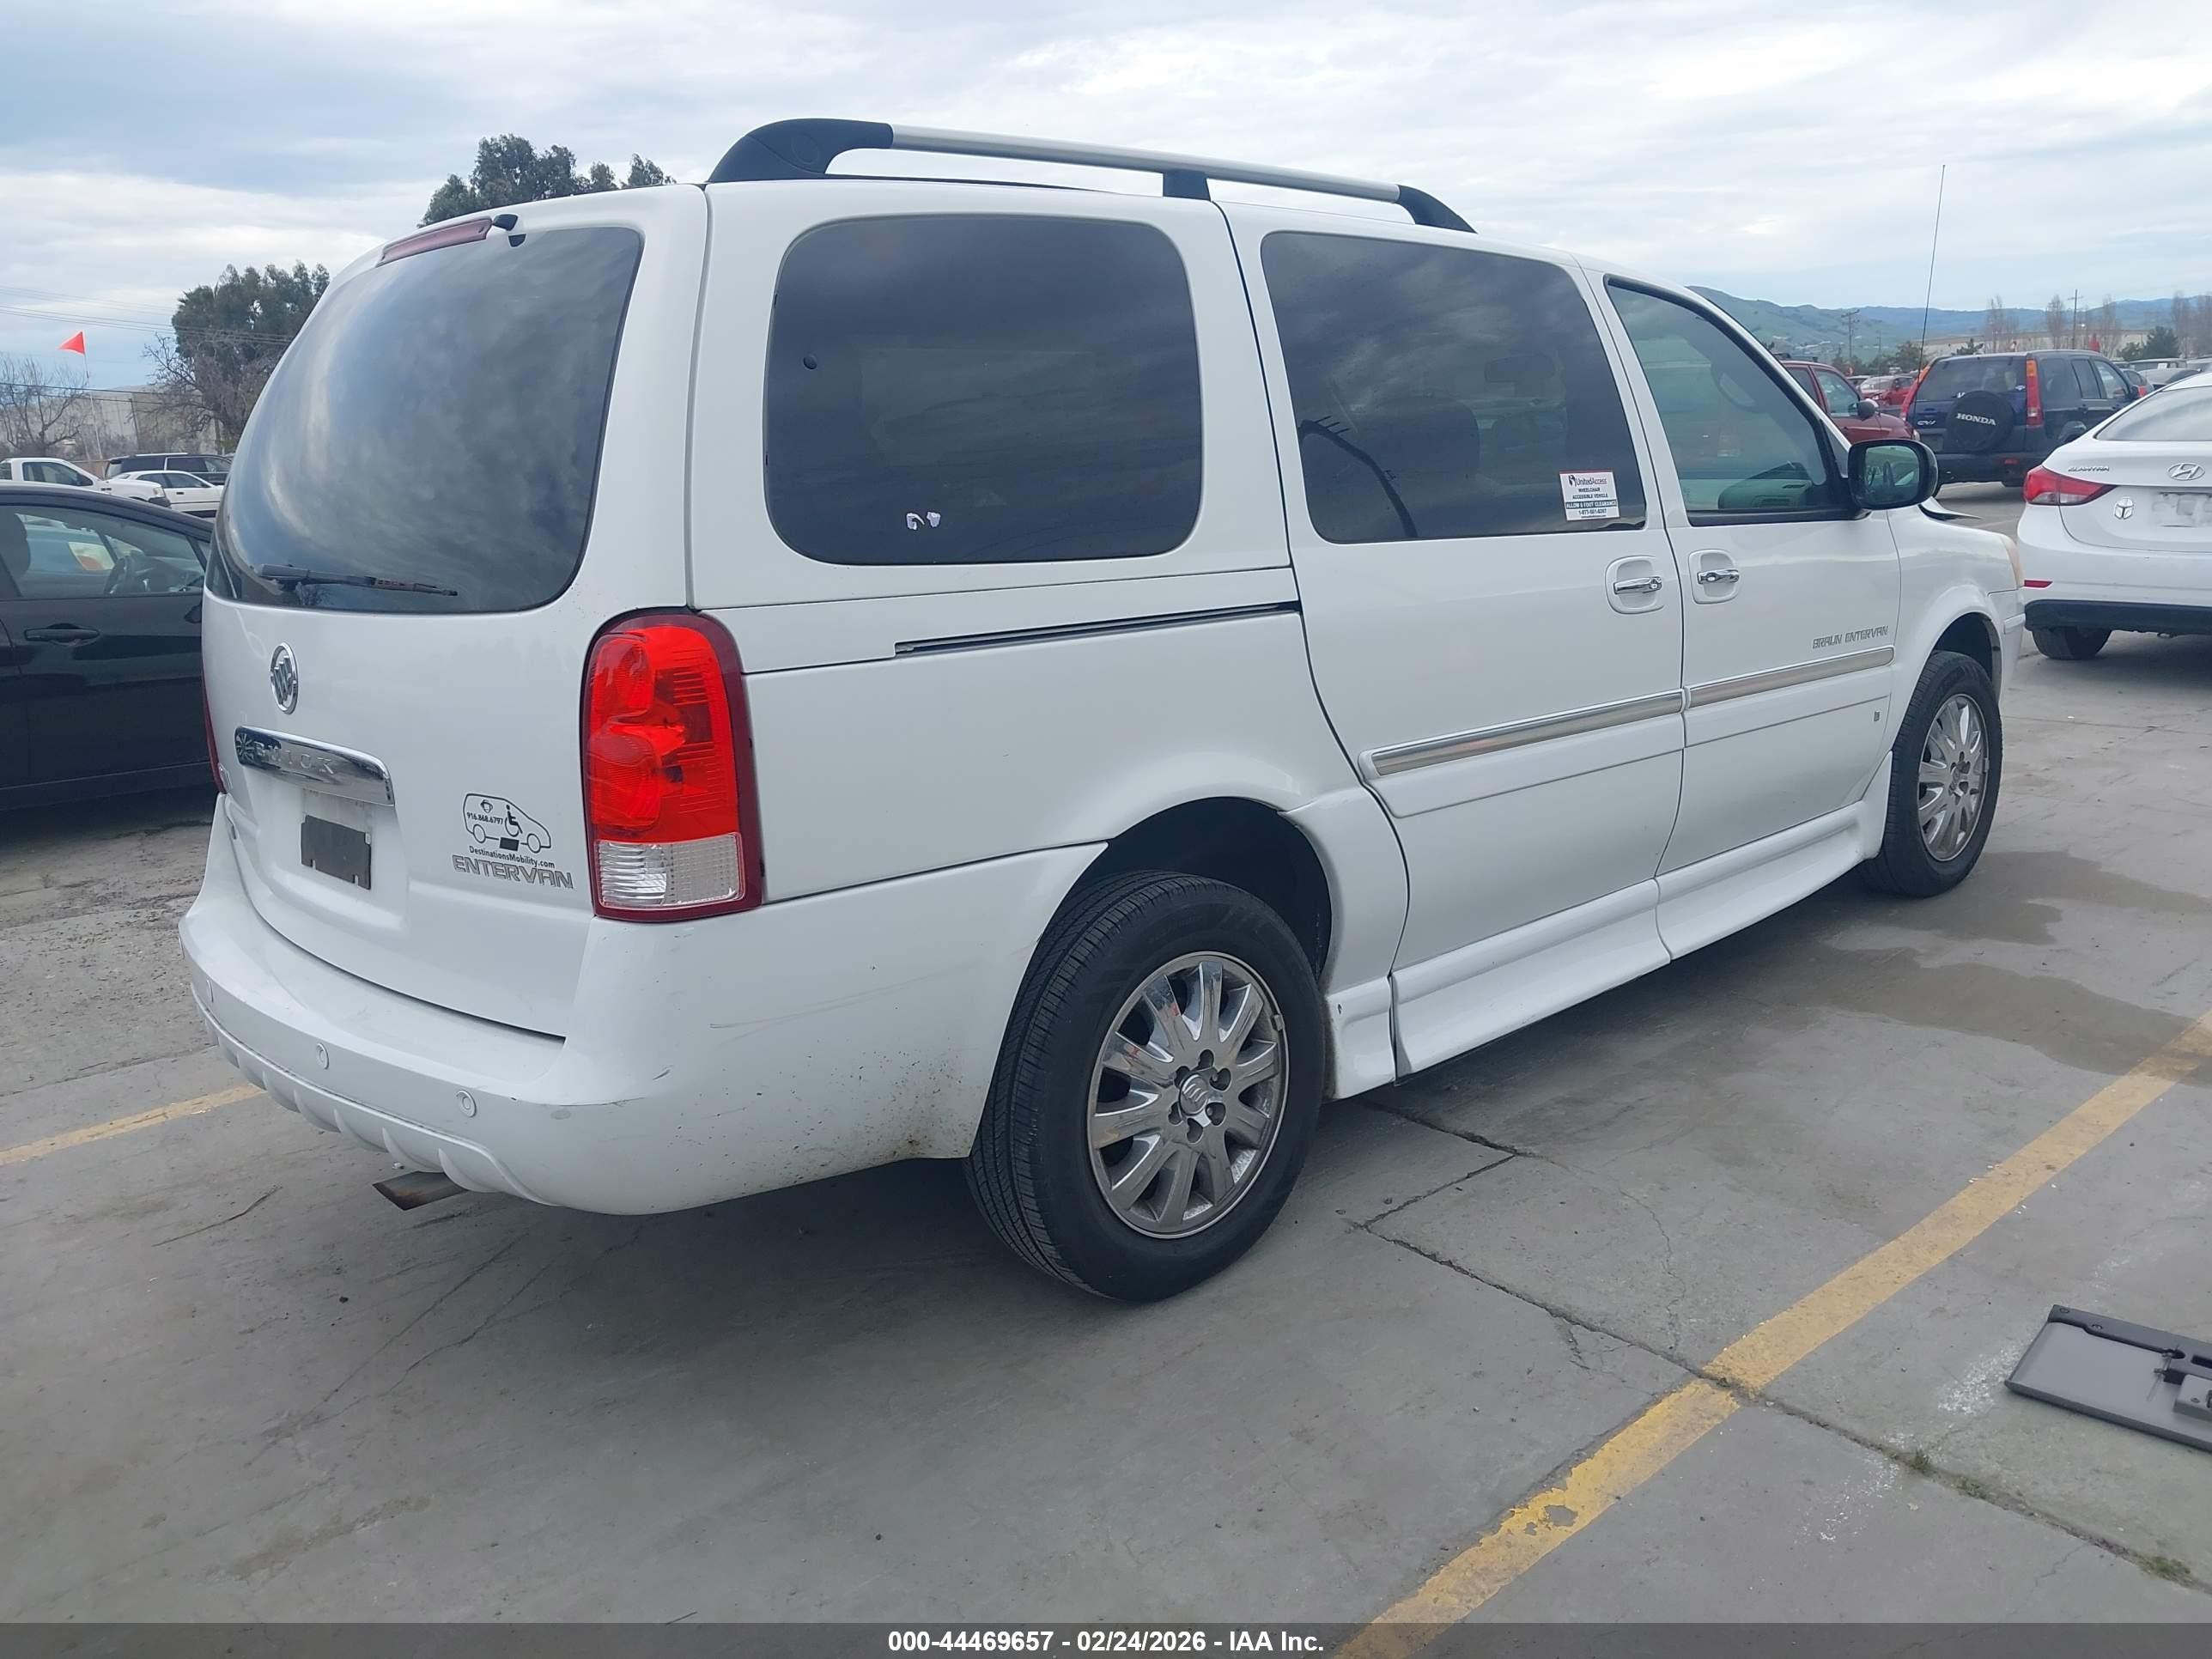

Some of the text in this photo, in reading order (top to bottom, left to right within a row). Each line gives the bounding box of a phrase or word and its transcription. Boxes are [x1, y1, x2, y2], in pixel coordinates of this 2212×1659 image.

[1955, 412, 1996, 426] HONDA
[1575, 477, 1607, 486] UnitedAccess
[1812, 625, 1889, 649] BRAUN ENTERVAN
[253, 740, 335, 775] BUICK
[469, 845, 556, 869] DestinationsMobility.com
[452, 854, 574, 890] ENTERVAN
